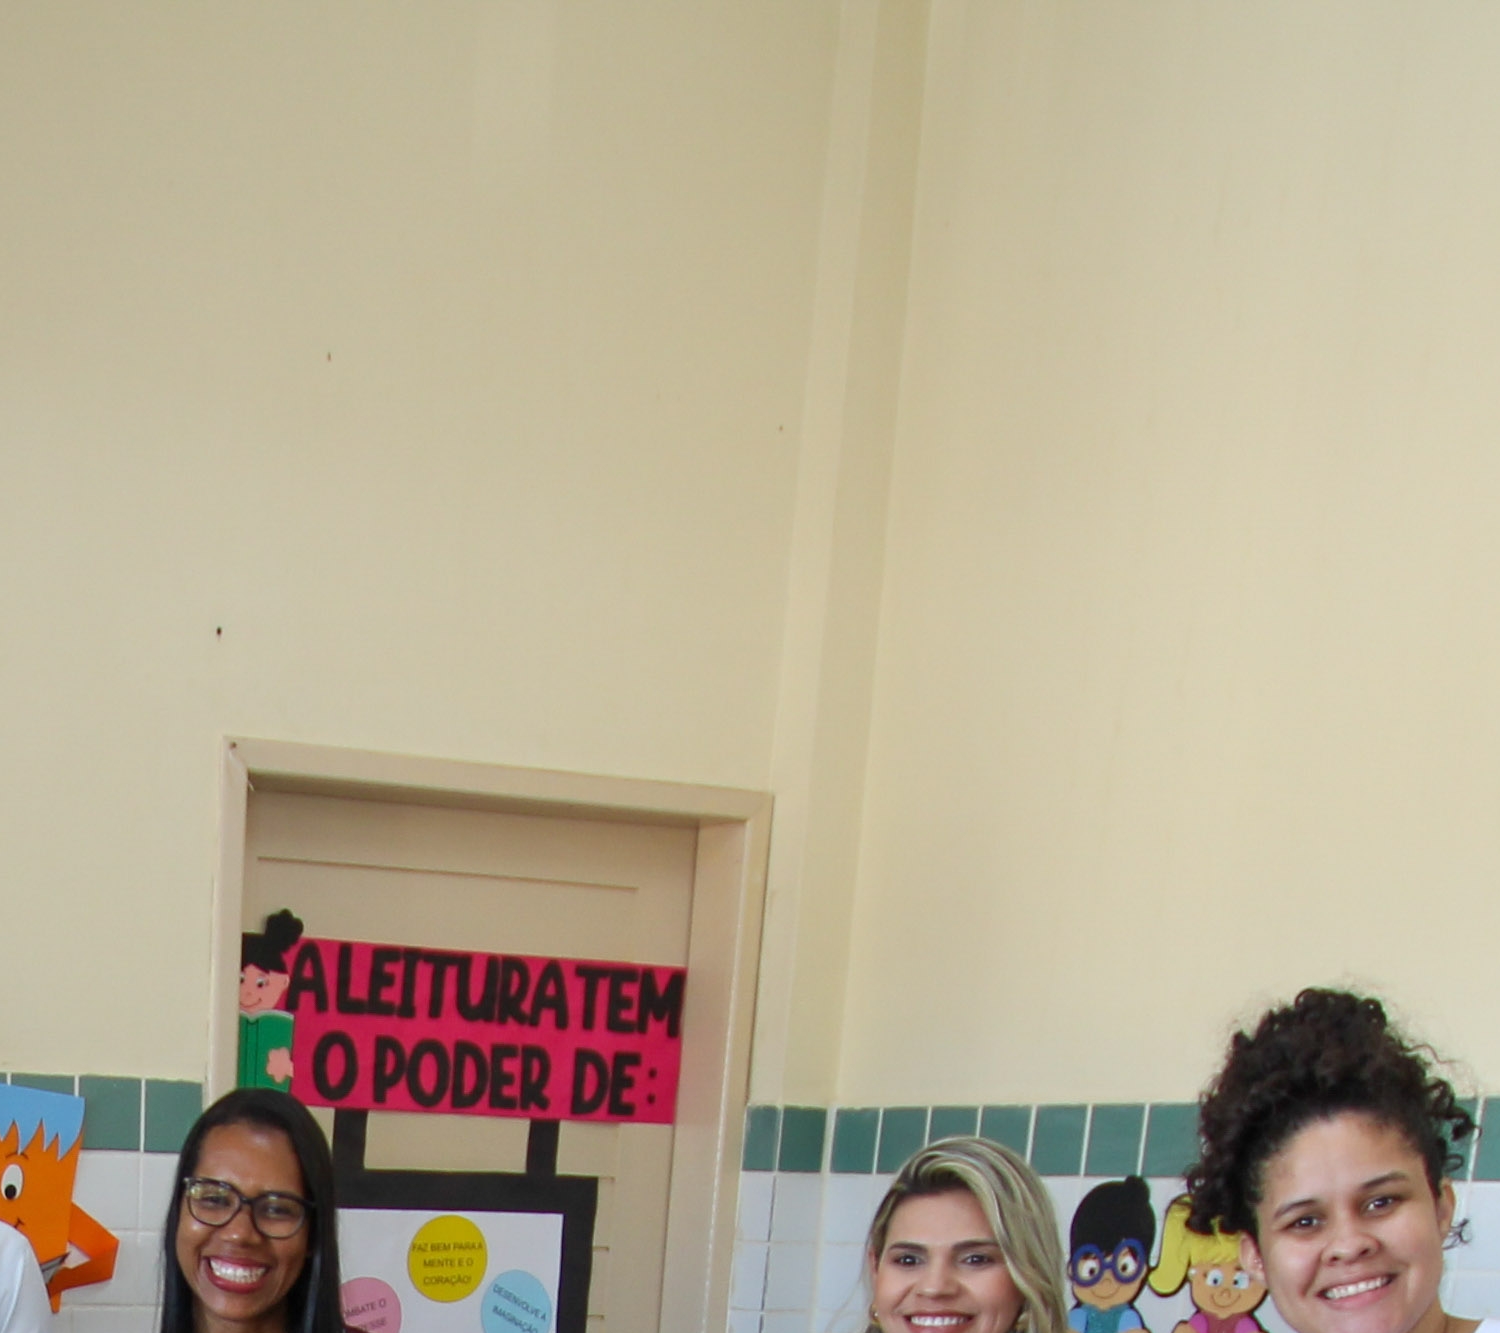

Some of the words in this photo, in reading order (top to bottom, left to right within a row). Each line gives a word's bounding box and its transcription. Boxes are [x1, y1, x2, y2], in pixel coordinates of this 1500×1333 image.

[286, 941, 328, 1013] A
[337, 943, 567, 1029] LEITURA
[575, 967, 685, 1039] TEM
[313, 1033, 358, 1100] O
[373, 1038, 551, 1111] PODER
[571, 1047, 658, 1117] DE:
[343, 1301, 376, 1318] OMBATE
